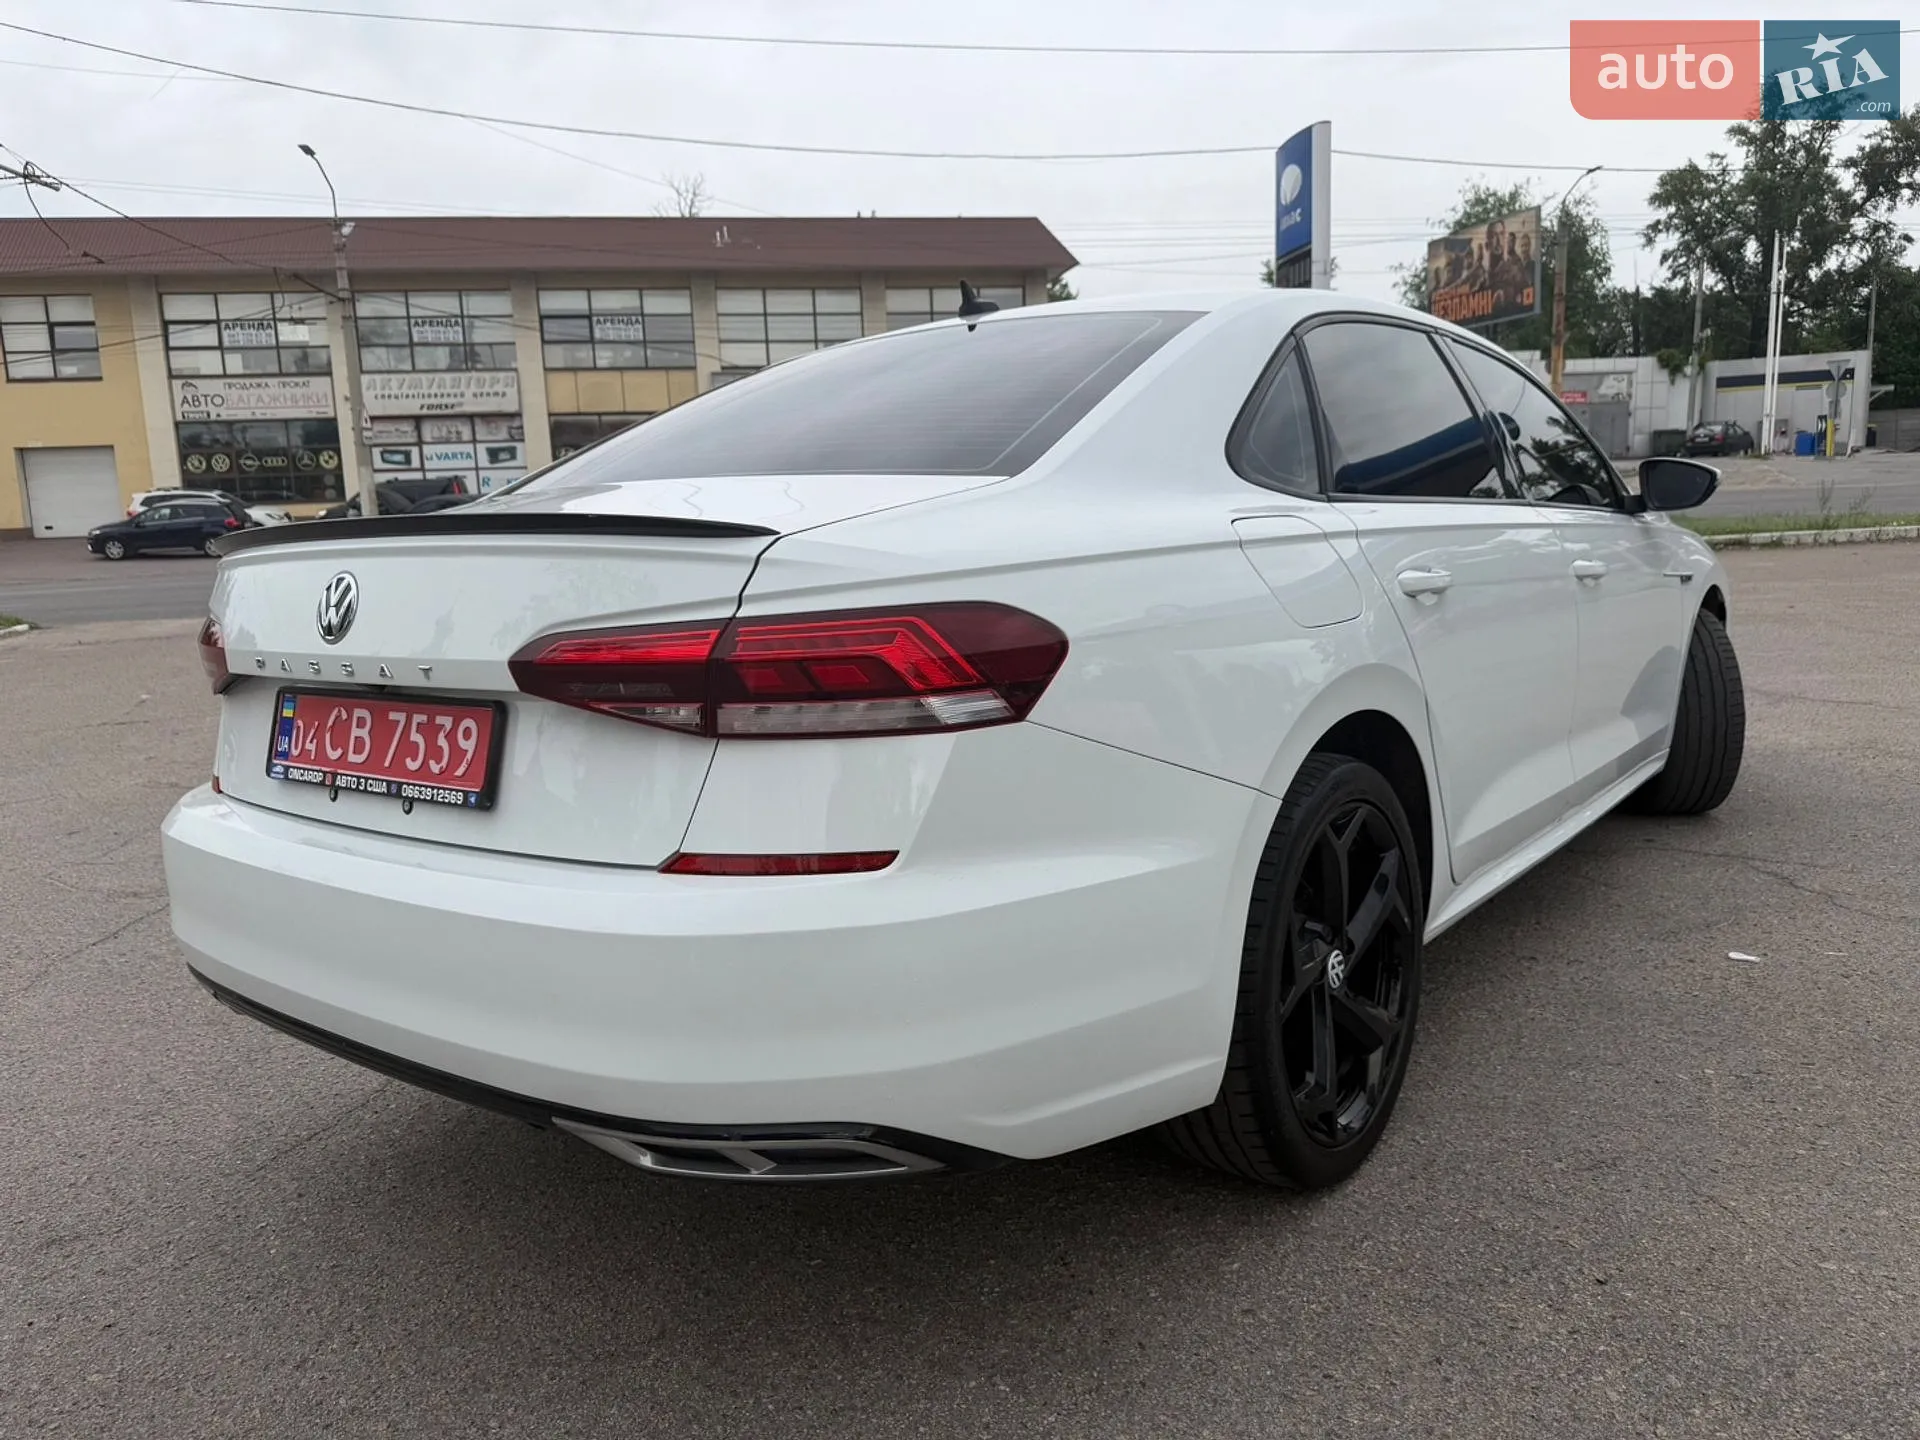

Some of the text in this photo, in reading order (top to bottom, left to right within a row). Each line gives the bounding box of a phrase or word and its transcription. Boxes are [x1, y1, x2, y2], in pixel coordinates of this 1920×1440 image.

[223, 321, 273, 331] АРЕНДА
[413, 318, 461, 328] АРЕНДА
[596, 317, 640, 326] АРЕНДА
[223, 381, 271, 391] ПРОДАЖА
[278, 379, 311, 390] ПРОКАТ
[435, 451, 473, 462] VARTA
[255, 656, 433, 681] PASSAT
[277, 735, 289, 752] UA
[291, 706, 479, 777] 04 CB 7539
[335, 775, 358, 789] АВТО
[366, 780, 388, 795] США
[401, 783, 464, 805] 0663912569
